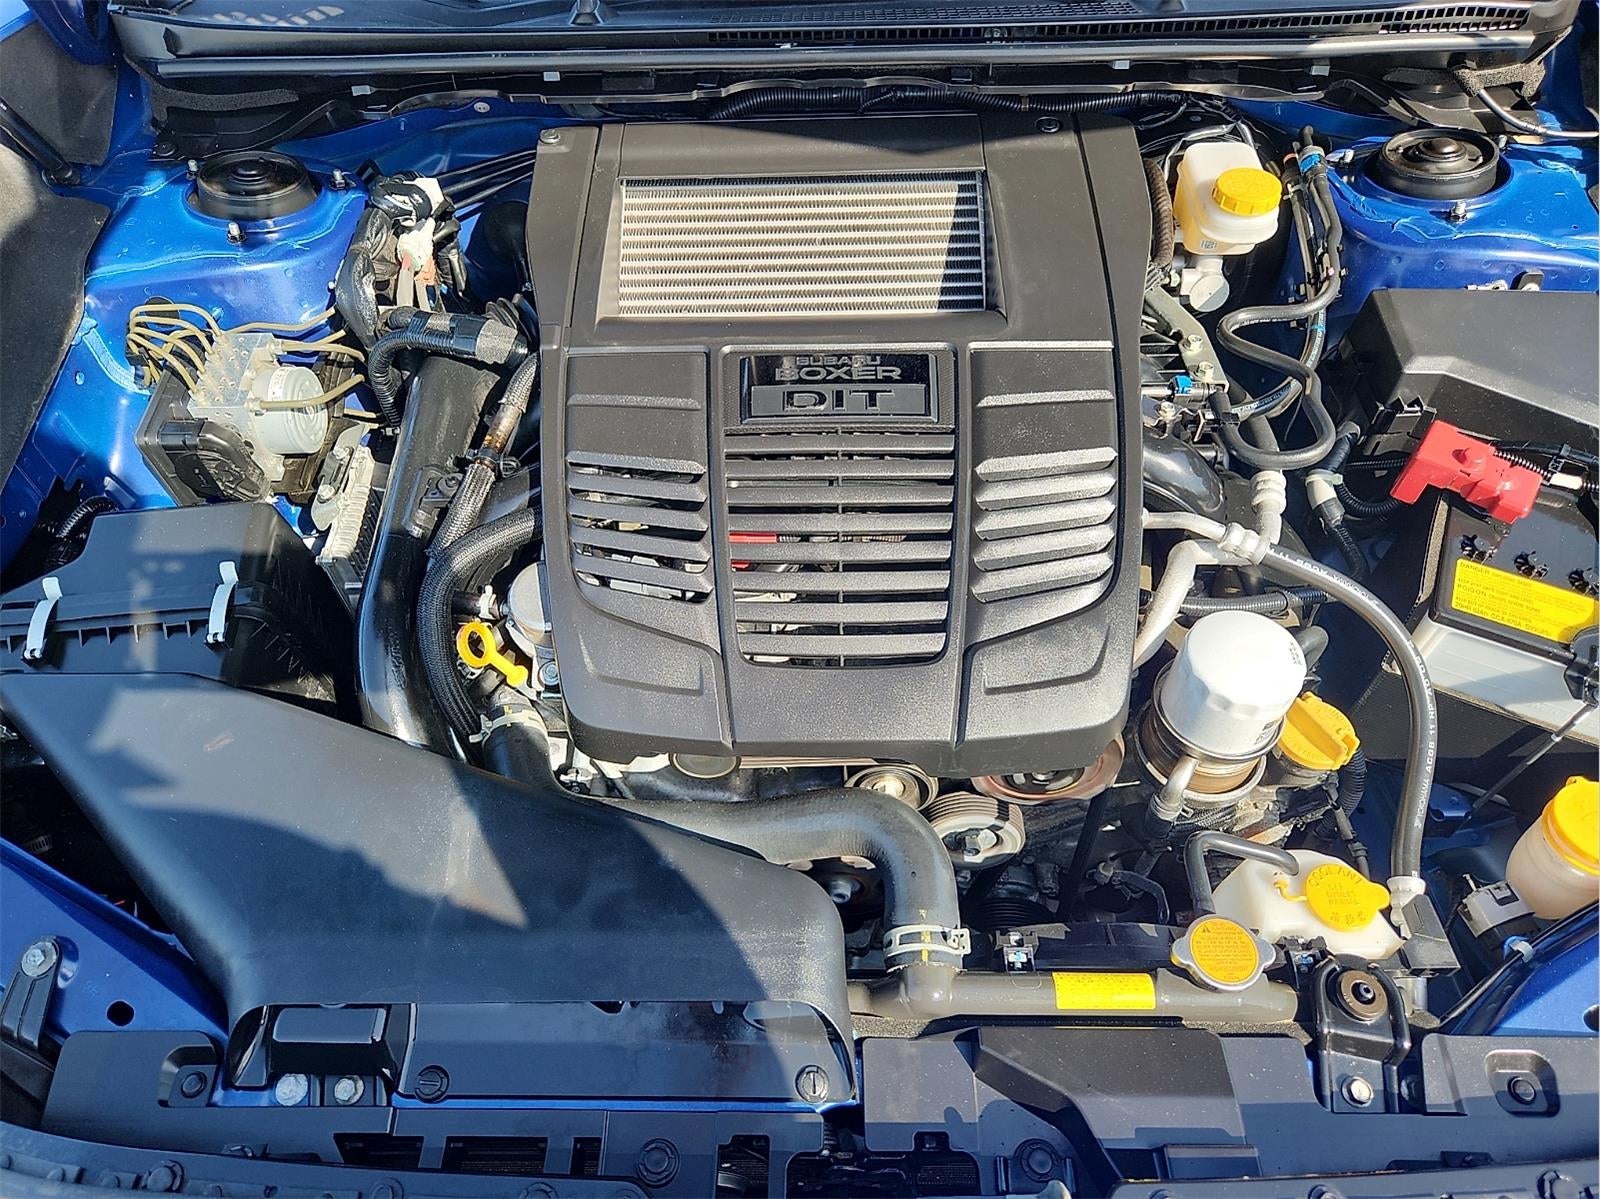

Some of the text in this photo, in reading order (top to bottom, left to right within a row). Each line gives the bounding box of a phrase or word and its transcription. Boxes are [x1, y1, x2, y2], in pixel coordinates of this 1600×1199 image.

[796, 356, 880, 366] SUBARU
[776, 366, 902, 381] BOXER
[783, 389, 895, 412] DIT
[1459, 561, 1490, 575] DANGER
[1456, 583, 1486, 596] POISON
[1308, 865, 1364, 888] COOLANT
